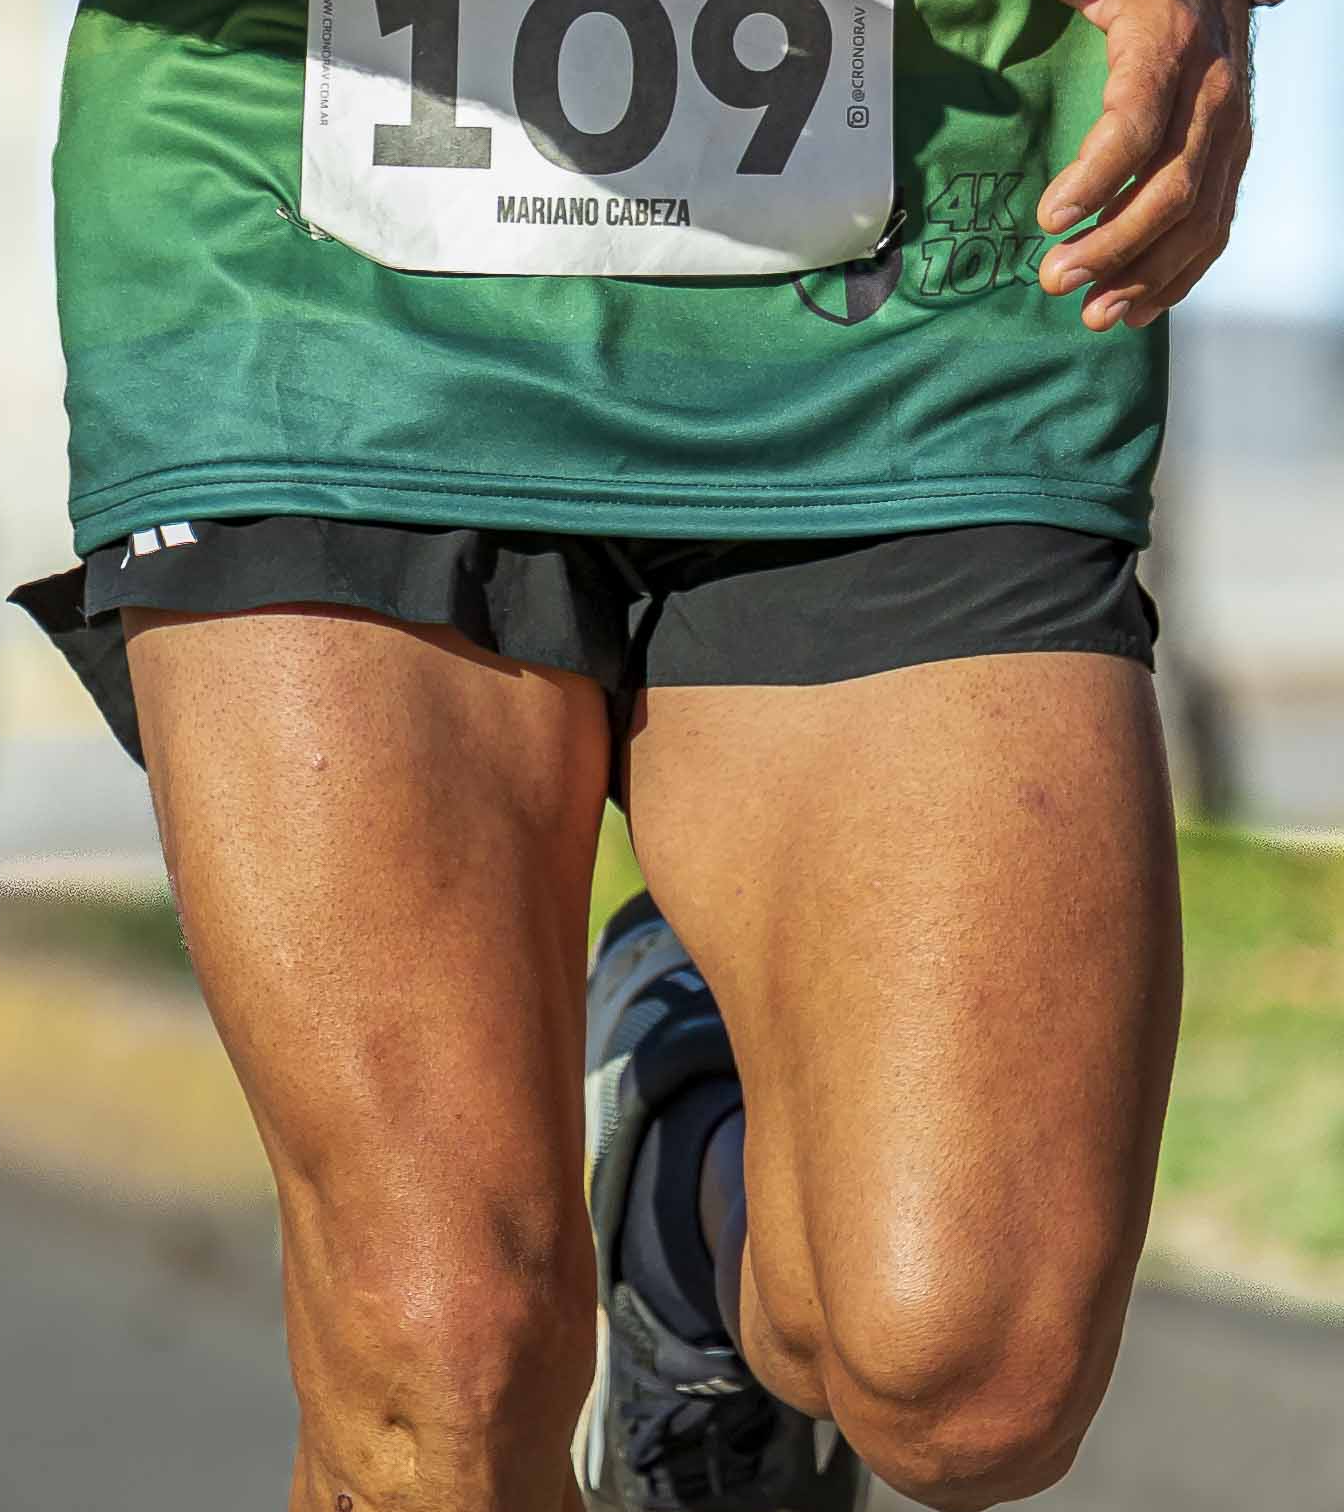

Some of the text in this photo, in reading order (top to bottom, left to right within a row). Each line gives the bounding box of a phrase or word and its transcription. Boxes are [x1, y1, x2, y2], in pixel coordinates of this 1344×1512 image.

[851, 7, 866, 103] @CRONORAV
[497, 194, 691, 228] MARIANO CABEZA
[927, 172, 1024, 232] 4K
[920, 236, 1045, 296] 10K
